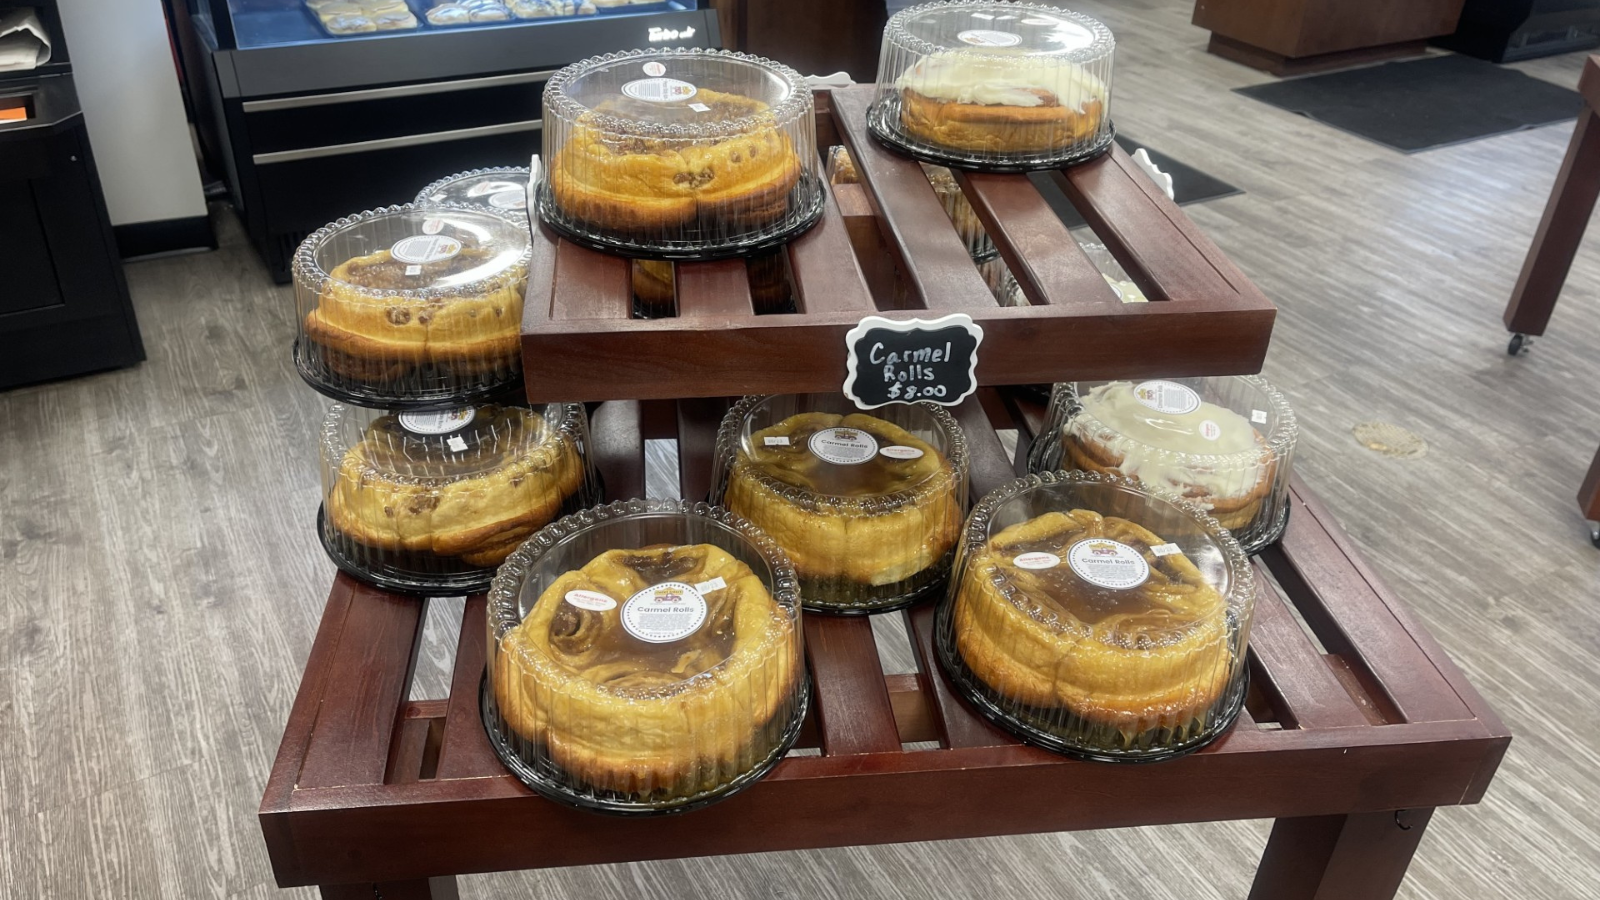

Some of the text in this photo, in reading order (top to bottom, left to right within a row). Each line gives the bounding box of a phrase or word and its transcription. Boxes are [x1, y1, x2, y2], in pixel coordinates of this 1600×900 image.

[869, 341, 952, 364] Carmel
[883, 364, 935, 382] Rolls
[887, 381, 947, 399] $8.00
